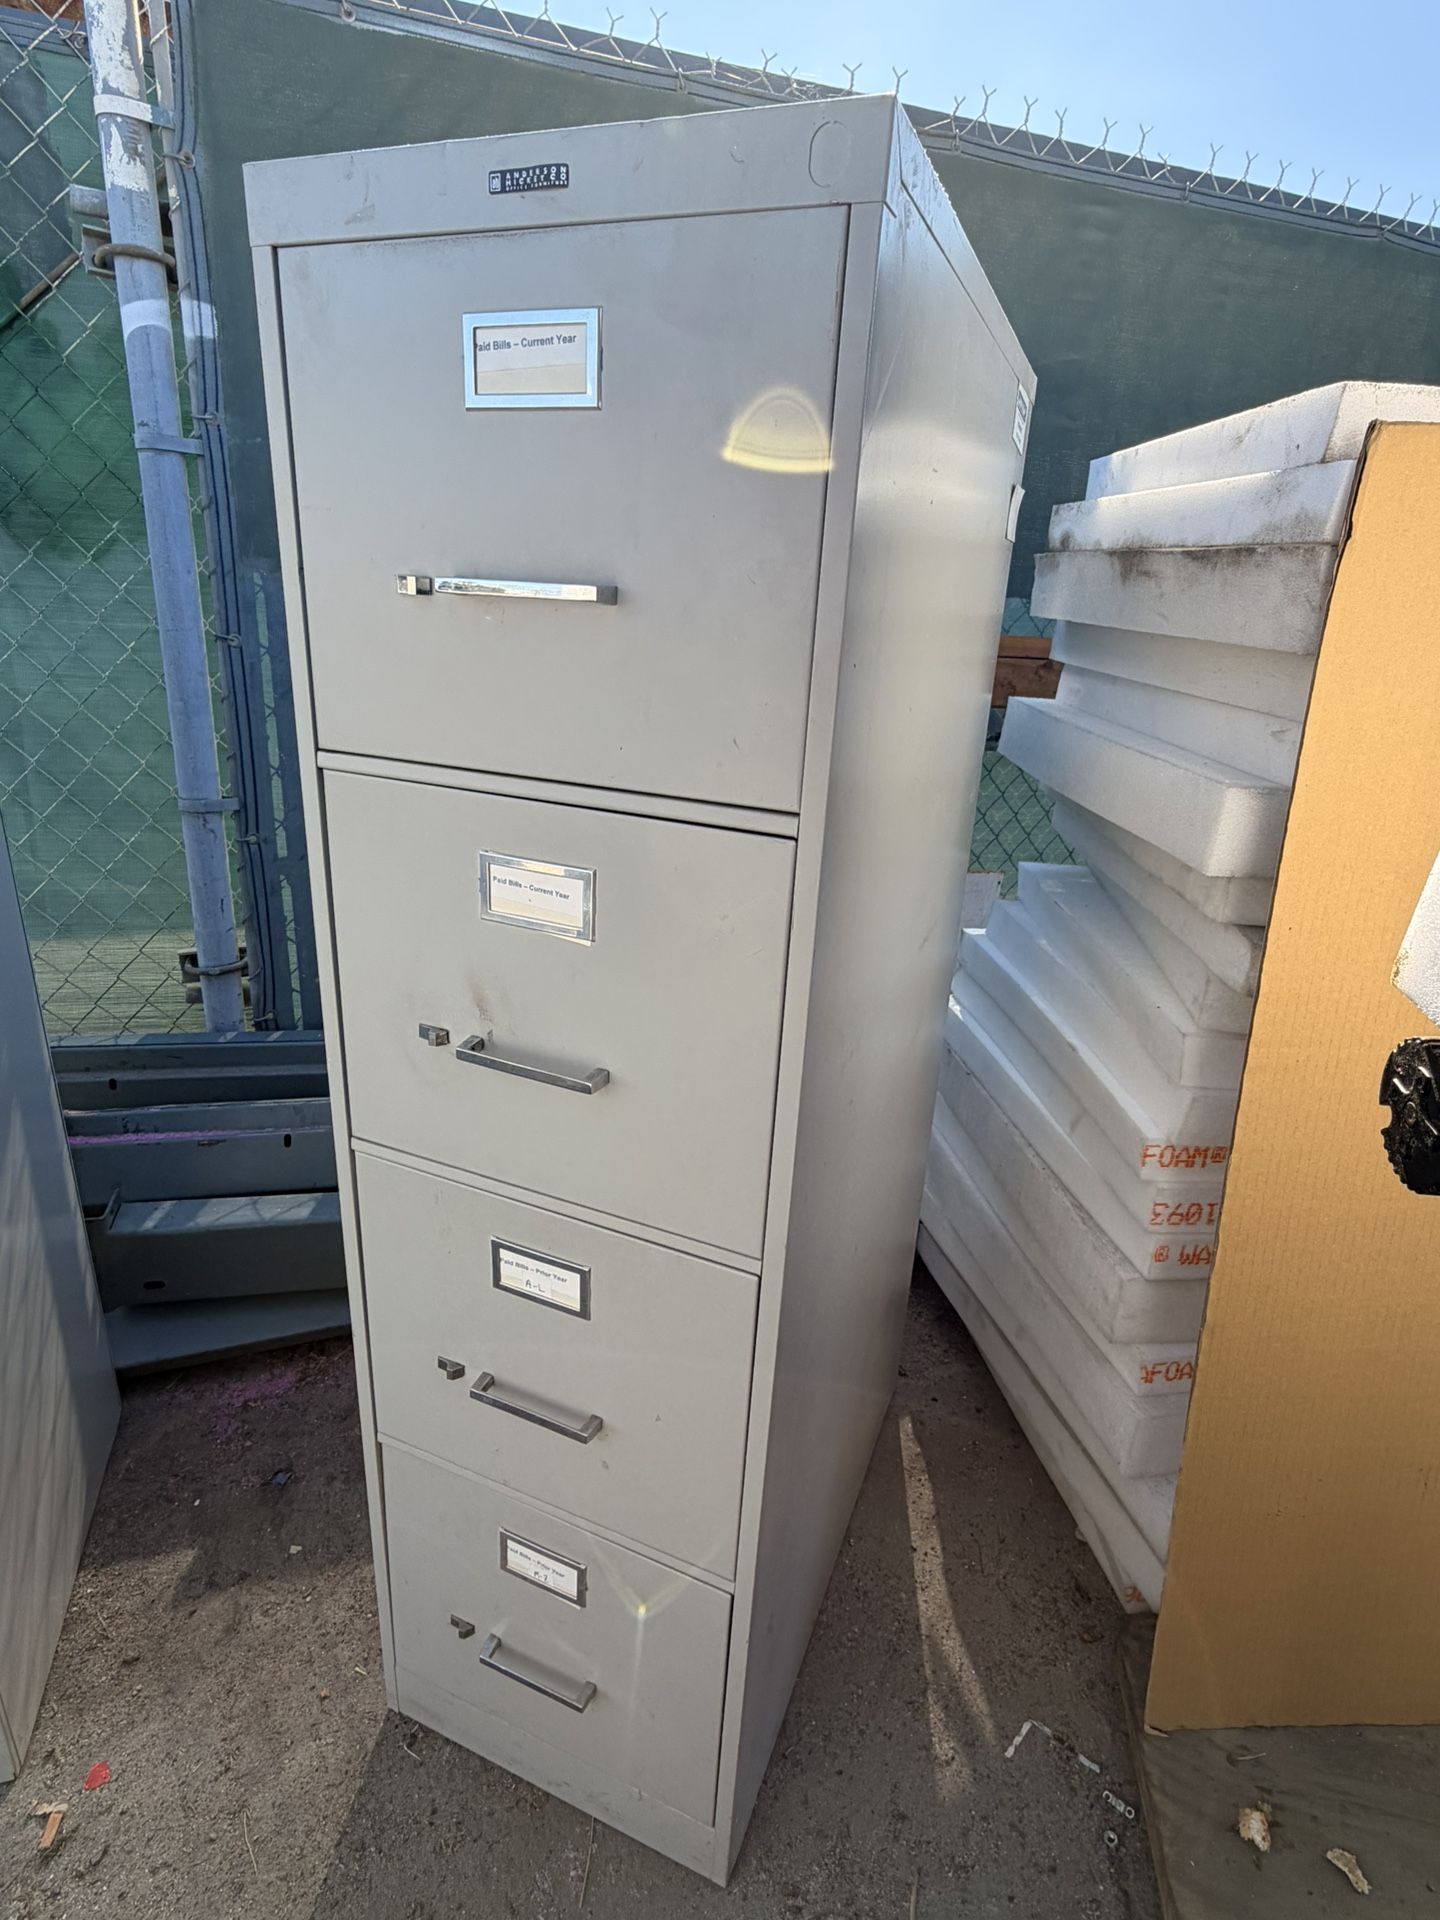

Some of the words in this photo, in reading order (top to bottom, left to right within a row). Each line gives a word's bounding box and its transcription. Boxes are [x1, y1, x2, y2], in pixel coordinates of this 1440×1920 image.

[505, 165, 567, 179] ANDERSON
[505, 174, 545, 187] HICKEY
[549, 173, 567, 181] CO
[493, 340, 511, 351] Bills
[521, 336, 554, 348] Current
[556, 334, 577, 344] Year
[493, 876, 508, 885] Paid
[508, 879, 523, 889] Bills
[529, 884, 554, 897] Current
[555, 890, 570, 900] Year
[536, 1268, 552, 1278] Prior
[552, 1273, 568, 1284] Year
[525, 1279, 546, 1293] A-L
